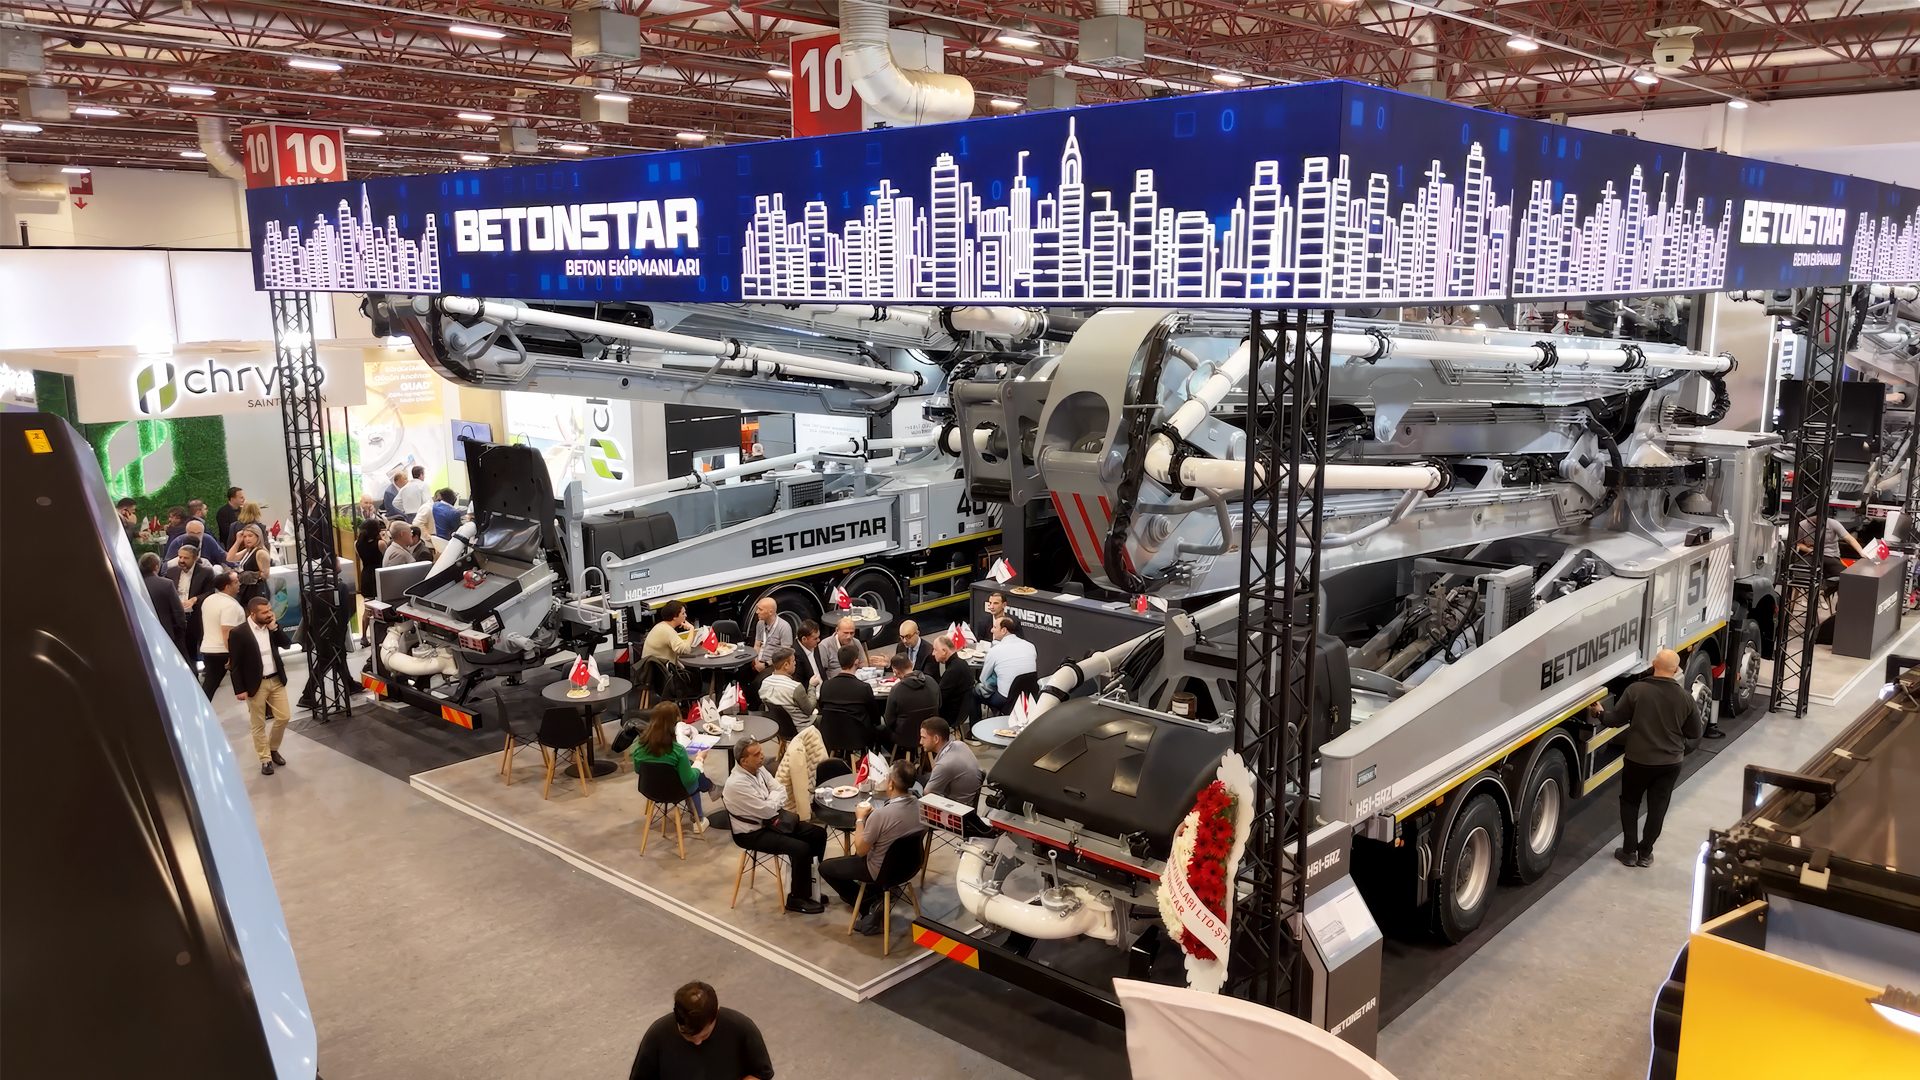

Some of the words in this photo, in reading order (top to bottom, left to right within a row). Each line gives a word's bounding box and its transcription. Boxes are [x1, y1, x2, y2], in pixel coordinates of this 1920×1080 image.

[801, 44, 853, 112] 10
[246, 133, 270, 174] 10
[286, 132, 336, 174] 10
[454, 197, 699, 252] BETONSTAR
[1740, 200, 1846, 245] BETONSTAR
[565, 259, 605, 276] BETON
[608, 255, 700, 276] EKİPMANLARI
[751, 516, 887, 559] BETONSTAR
[1541, 616, 1639, 691] BETONSTAR
